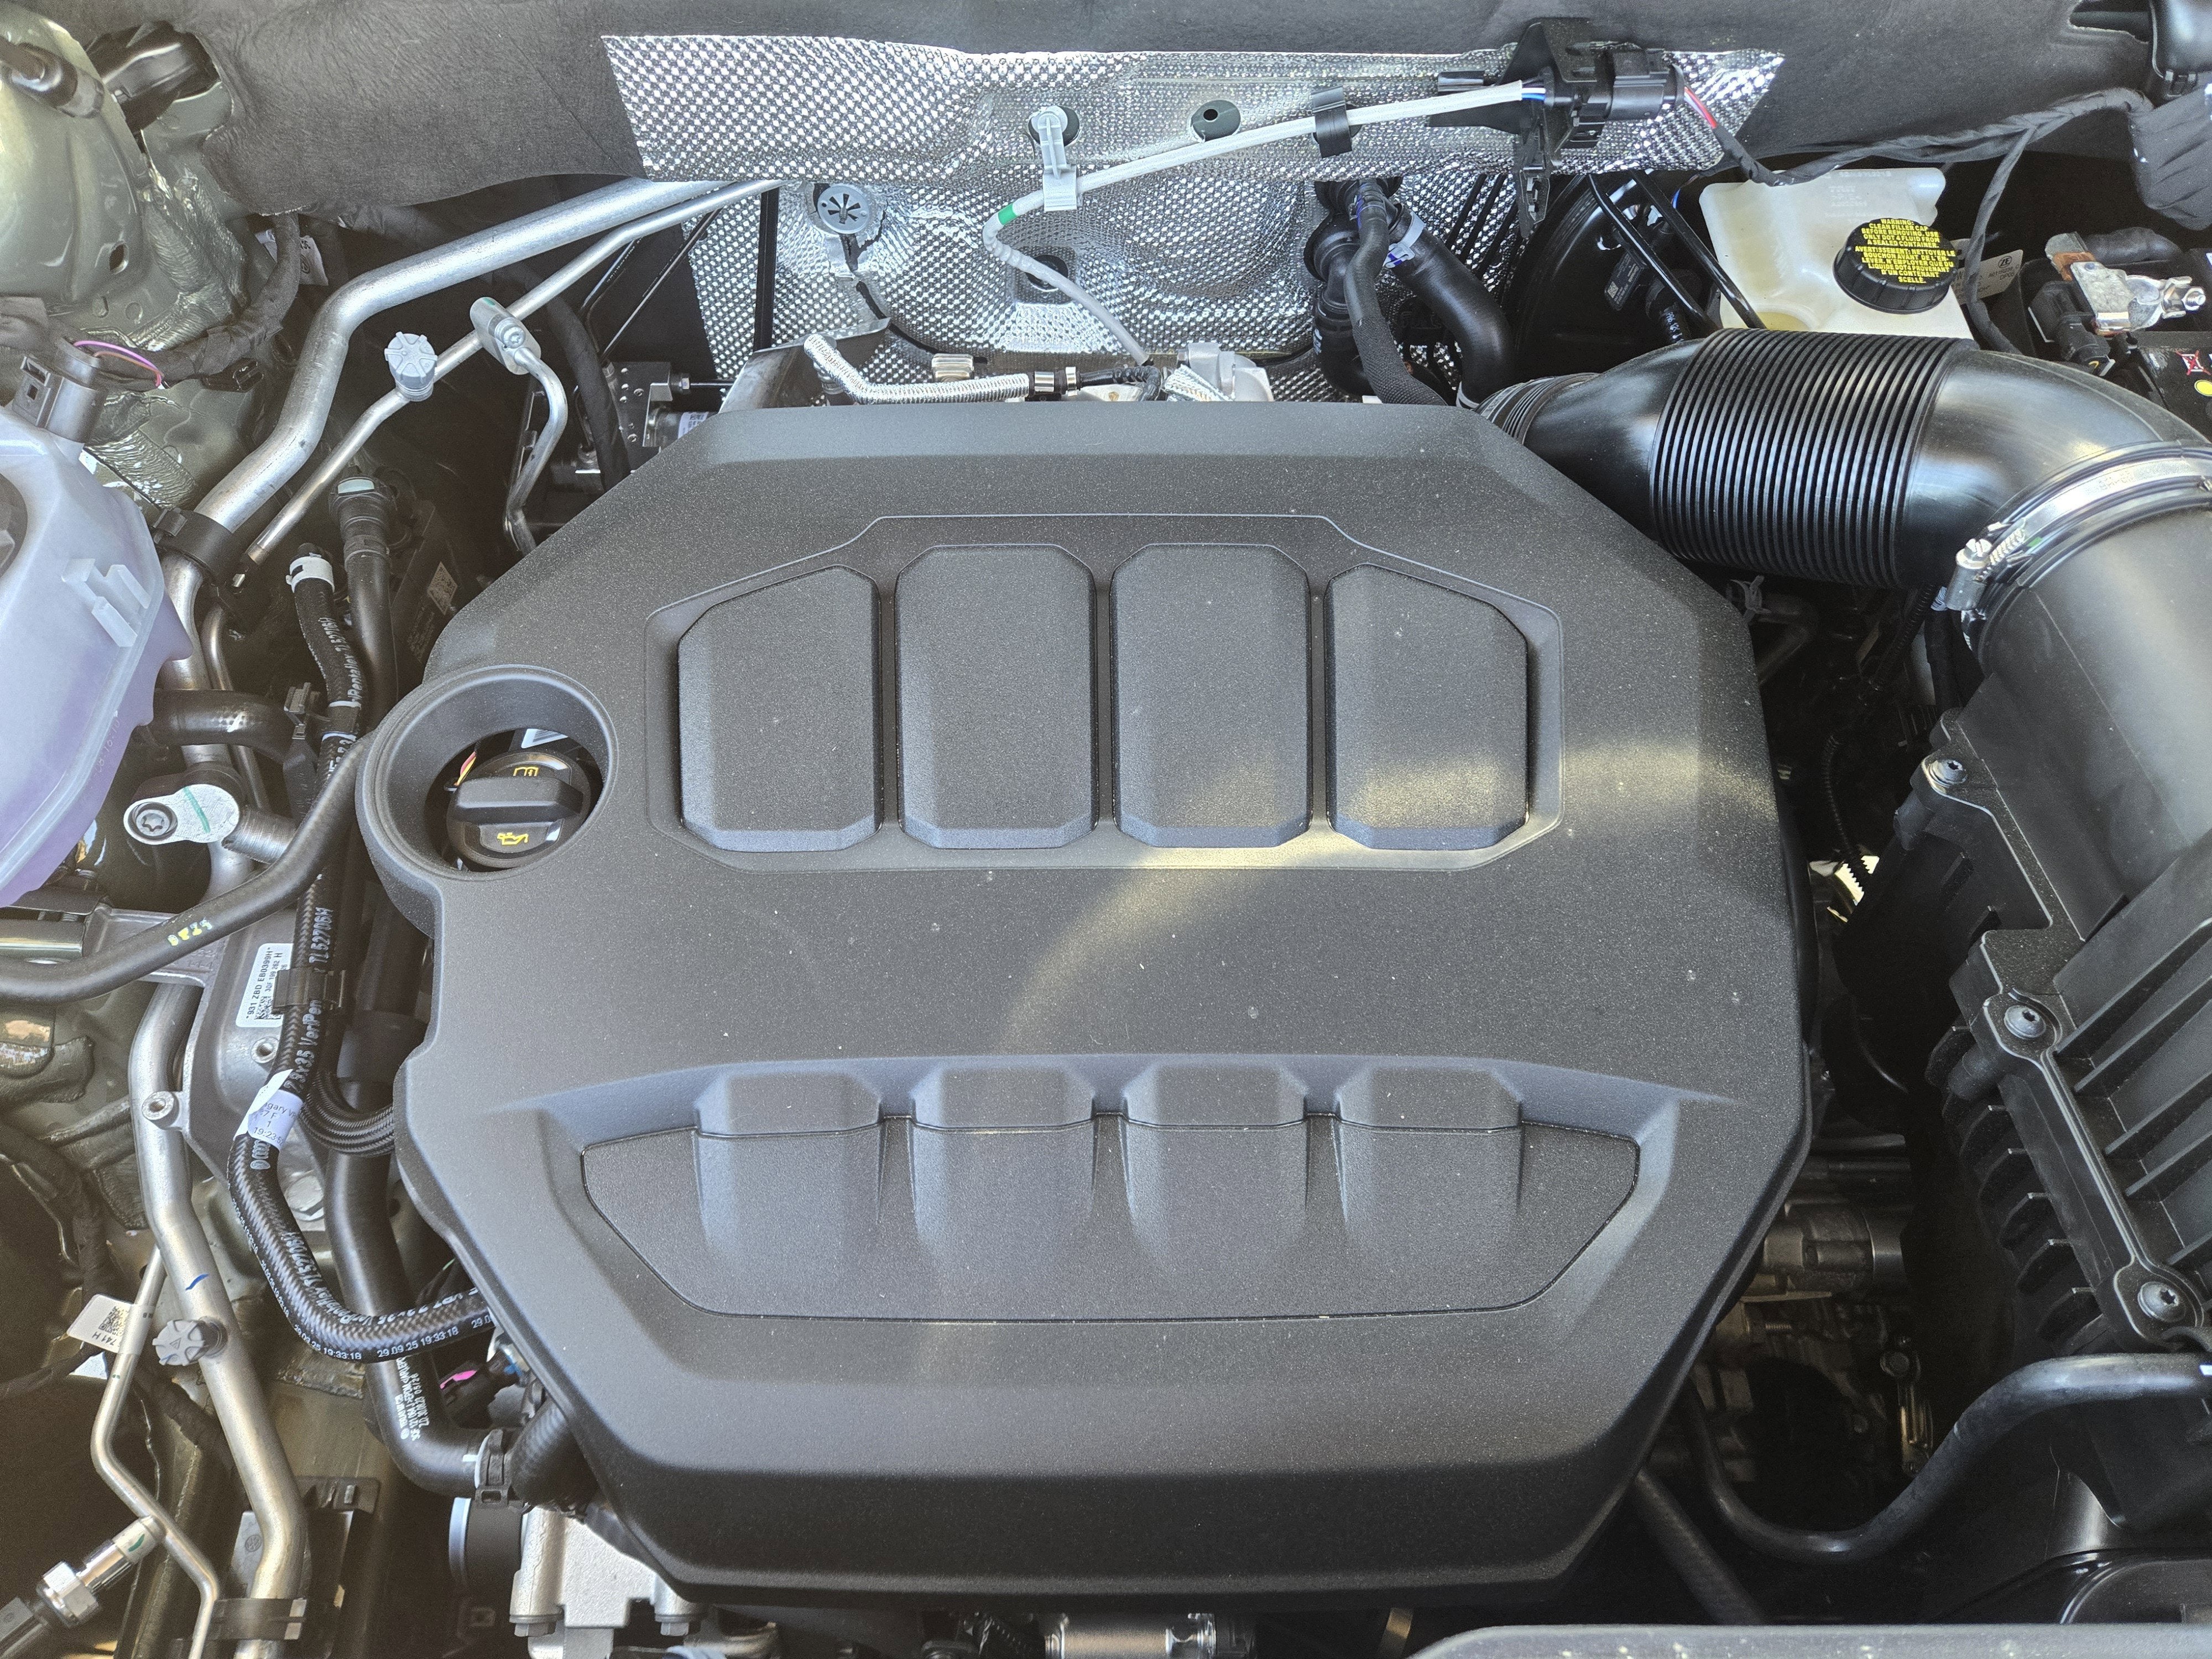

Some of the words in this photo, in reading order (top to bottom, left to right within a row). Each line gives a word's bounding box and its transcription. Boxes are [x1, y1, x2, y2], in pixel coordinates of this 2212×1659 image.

[1855, 246, 1911, 254] AVERTISSEMENT:
[272, 960, 280, 969] 262
[252, 984, 262, 999] ZBD
[92, 1331, 101, 1339] H
[101, 1334, 117, 1346] 741
[420, 1327, 460, 1347] 19:33:18
